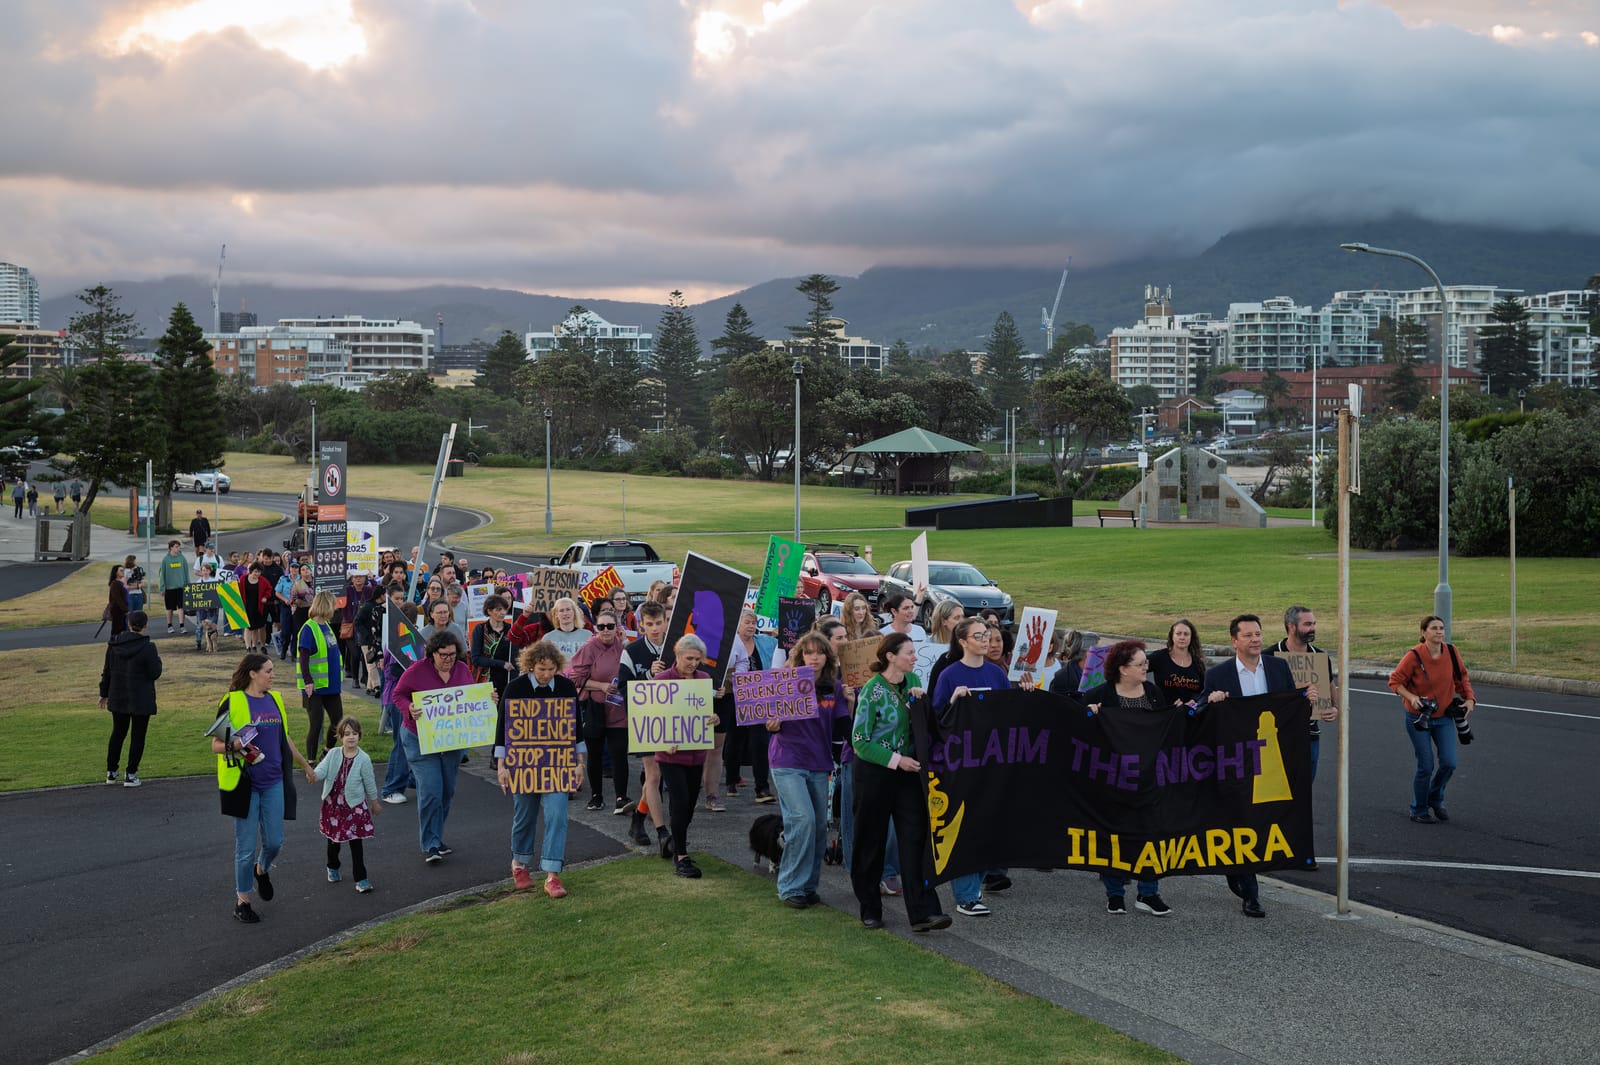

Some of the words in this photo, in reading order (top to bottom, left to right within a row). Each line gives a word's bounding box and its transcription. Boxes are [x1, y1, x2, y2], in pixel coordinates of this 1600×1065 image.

[317, 524, 332, 534] PUBLIC
[333, 522, 346, 532] PLACE
[346, 544, 366, 552] 2025
[534, 572, 542, 586] 1
[544, 570, 579, 590] PERSON
[755, 542, 776, 614] RESPECT
[535, 589, 544, 599] IS
[580, 568, 623, 609] RESPECT
[192, 600, 212, 608] NIGHT
[736, 674, 762, 686] END
[770, 669, 798, 680] THE
[422, 690, 464, 705] STOP
[632, 682, 680, 705] STOP
[684, 692, 706, 710] the
[736, 682, 794, 701] SILENCE
[426, 701, 488, 720] VIOLENCE
[509, 699, 541, 718] END
[544, 699, 574, 718] THE
[738, 696, 815, 722] VIOLENCE
[508, 719, 576, 740] SILENCE
[632, 715, 712, 744] VIOLENCE
[505, 748, 544, 767] STOP
[547, 748, 576, 767] THE
[1071, 737, 1140, 791] THE
[1155, 740, 1267, 787] NIGHT
[507, 766, 577, 794] VIOLENCE
[1067, 823, 1294, 875] ILLAWARRA
